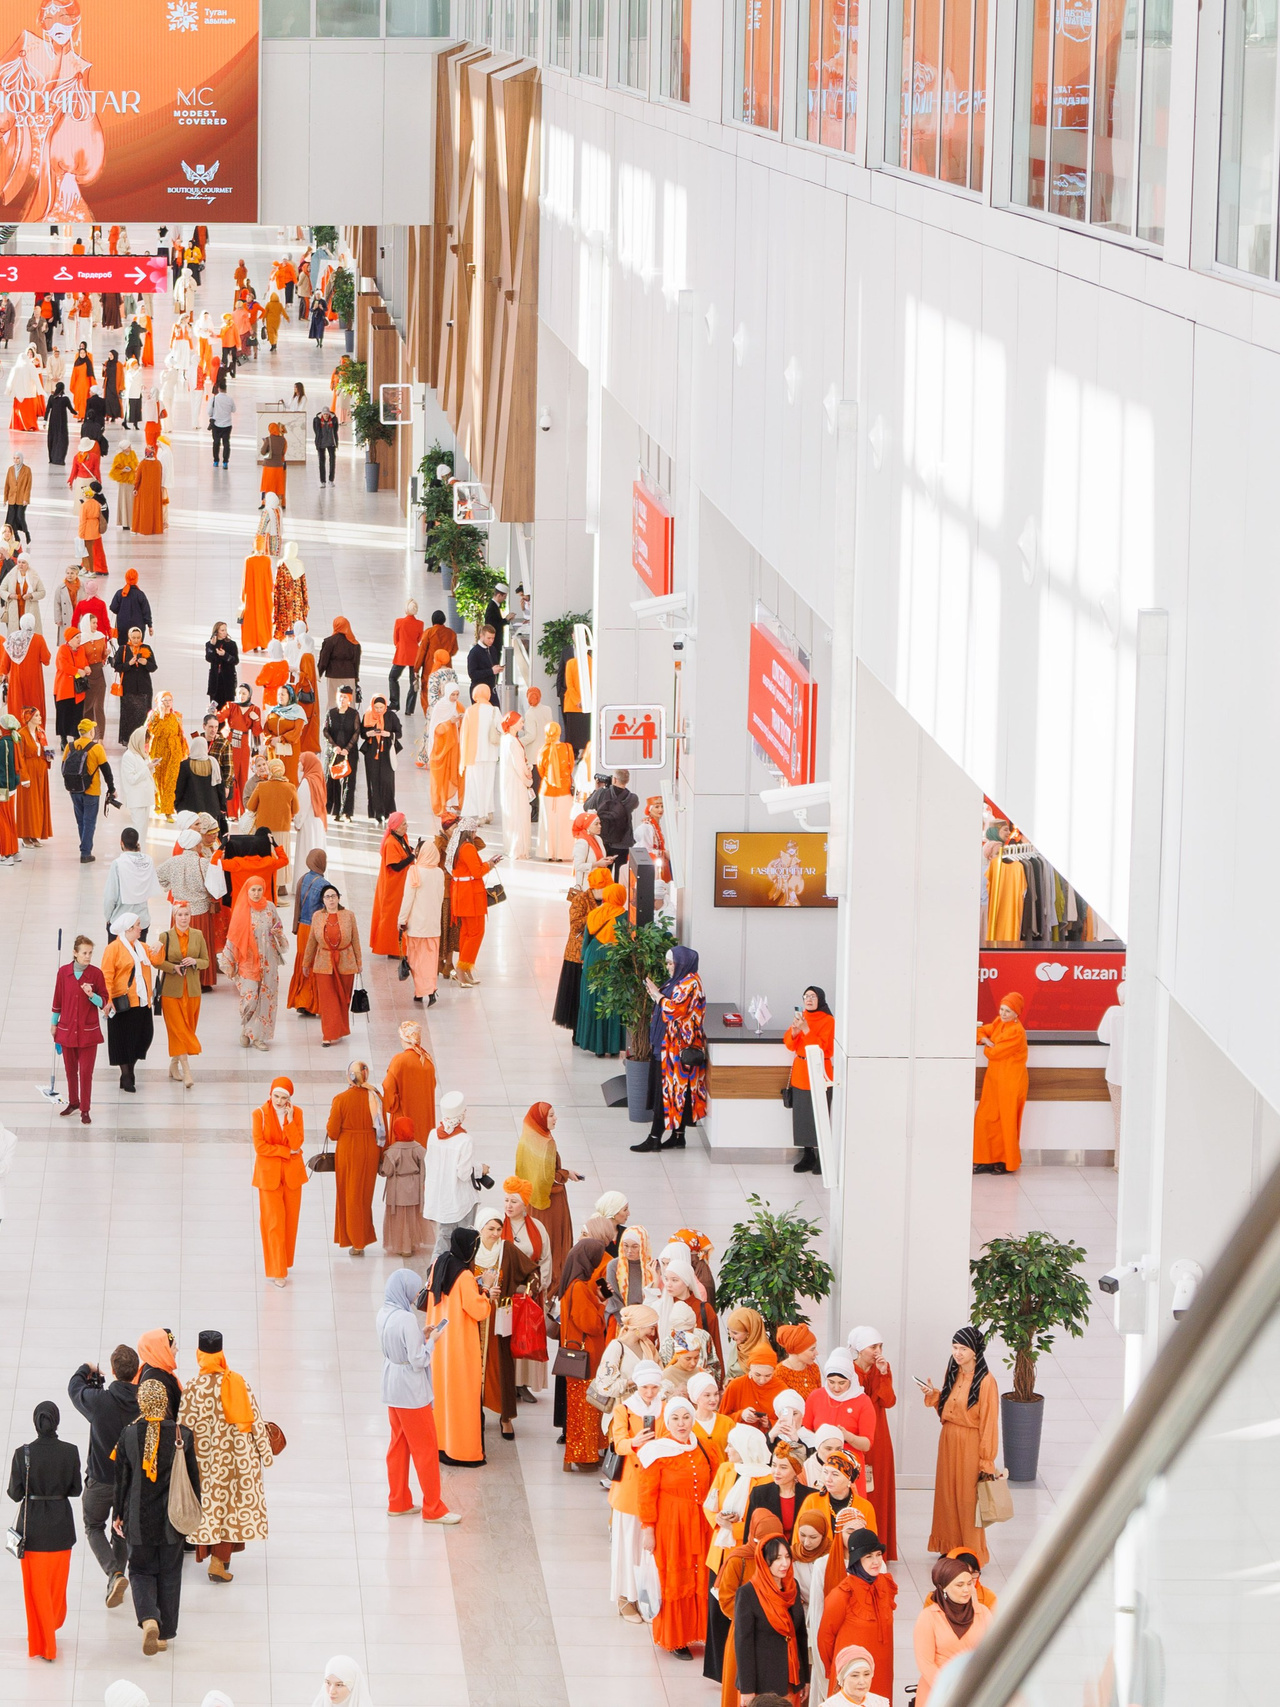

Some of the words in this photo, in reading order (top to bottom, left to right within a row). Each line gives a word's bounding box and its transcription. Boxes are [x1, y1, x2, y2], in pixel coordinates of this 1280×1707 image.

[176, 87, 214, 106] MC
[15, 114, 54, 128] 2025
[173, 110, 217, 118] MODEST
[77, 271, 112, 280] Гардероб
[1073, 965, 1118, 980] Kazan
